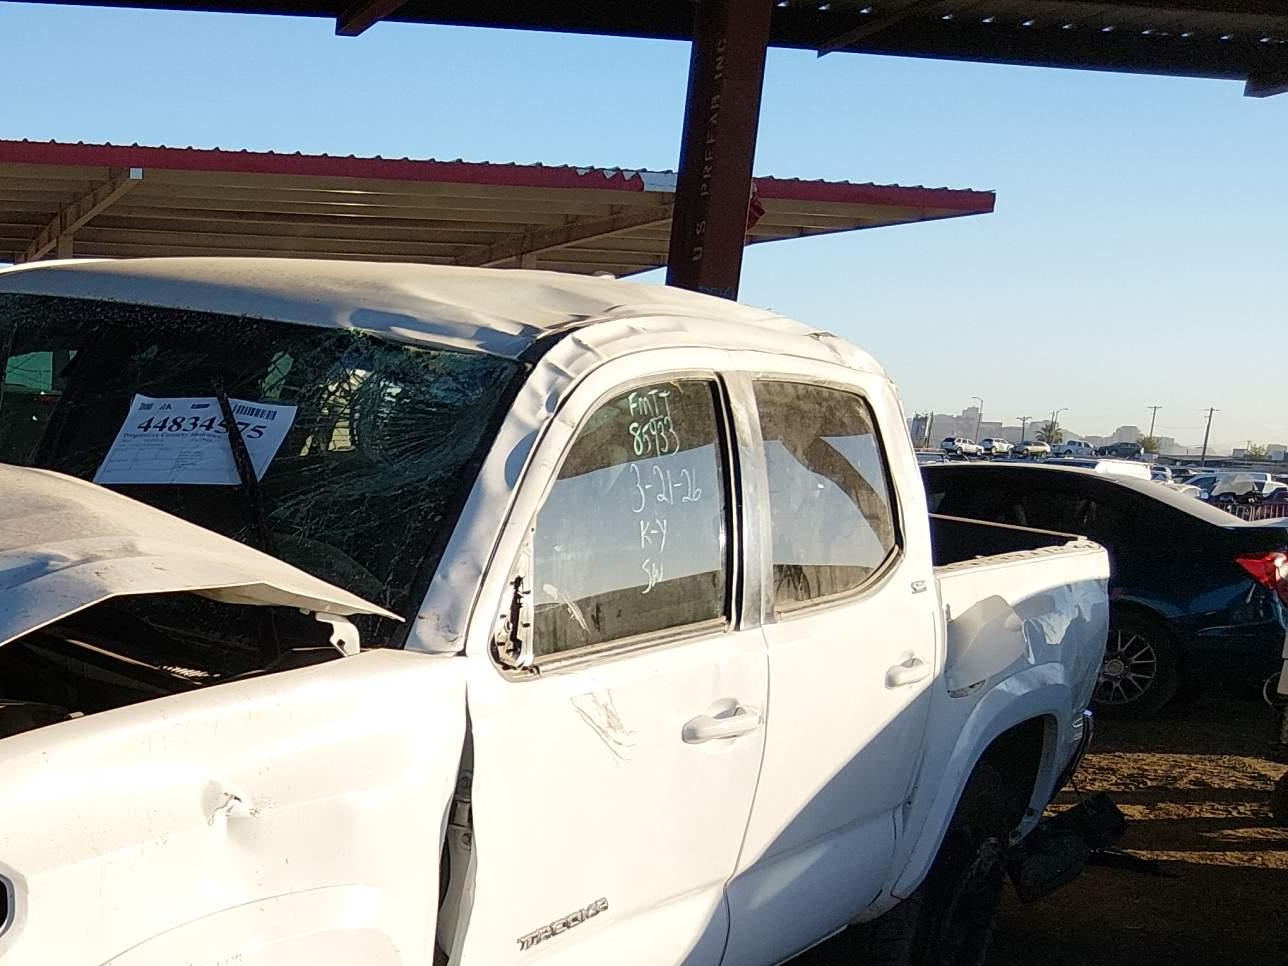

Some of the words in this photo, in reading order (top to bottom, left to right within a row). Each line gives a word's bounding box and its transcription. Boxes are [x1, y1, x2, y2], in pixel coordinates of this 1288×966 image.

[137, 416, 267, 439] 44834575
[629, 416, 680, 456] 85933
[517, 896, 609, 952] TACOMA
